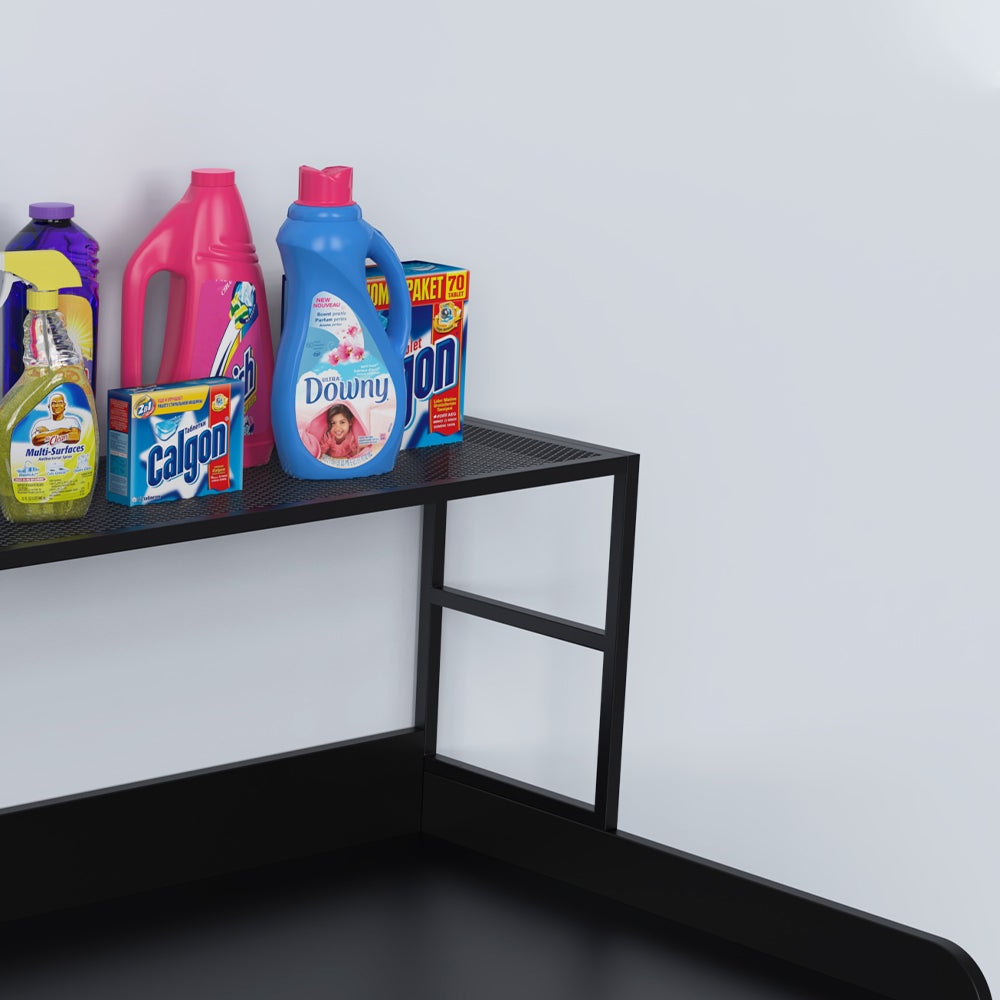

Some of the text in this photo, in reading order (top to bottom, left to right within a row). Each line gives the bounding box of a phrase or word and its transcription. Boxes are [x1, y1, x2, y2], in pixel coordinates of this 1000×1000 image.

[406, 276, 443, 302] PAKET
[448, 274, 465, 292] 70
[304, 377, 388, 404] Downy
[25, 444, 85, 457] Multi-Surfaces
[147, 421, 228, 487] Calgon
